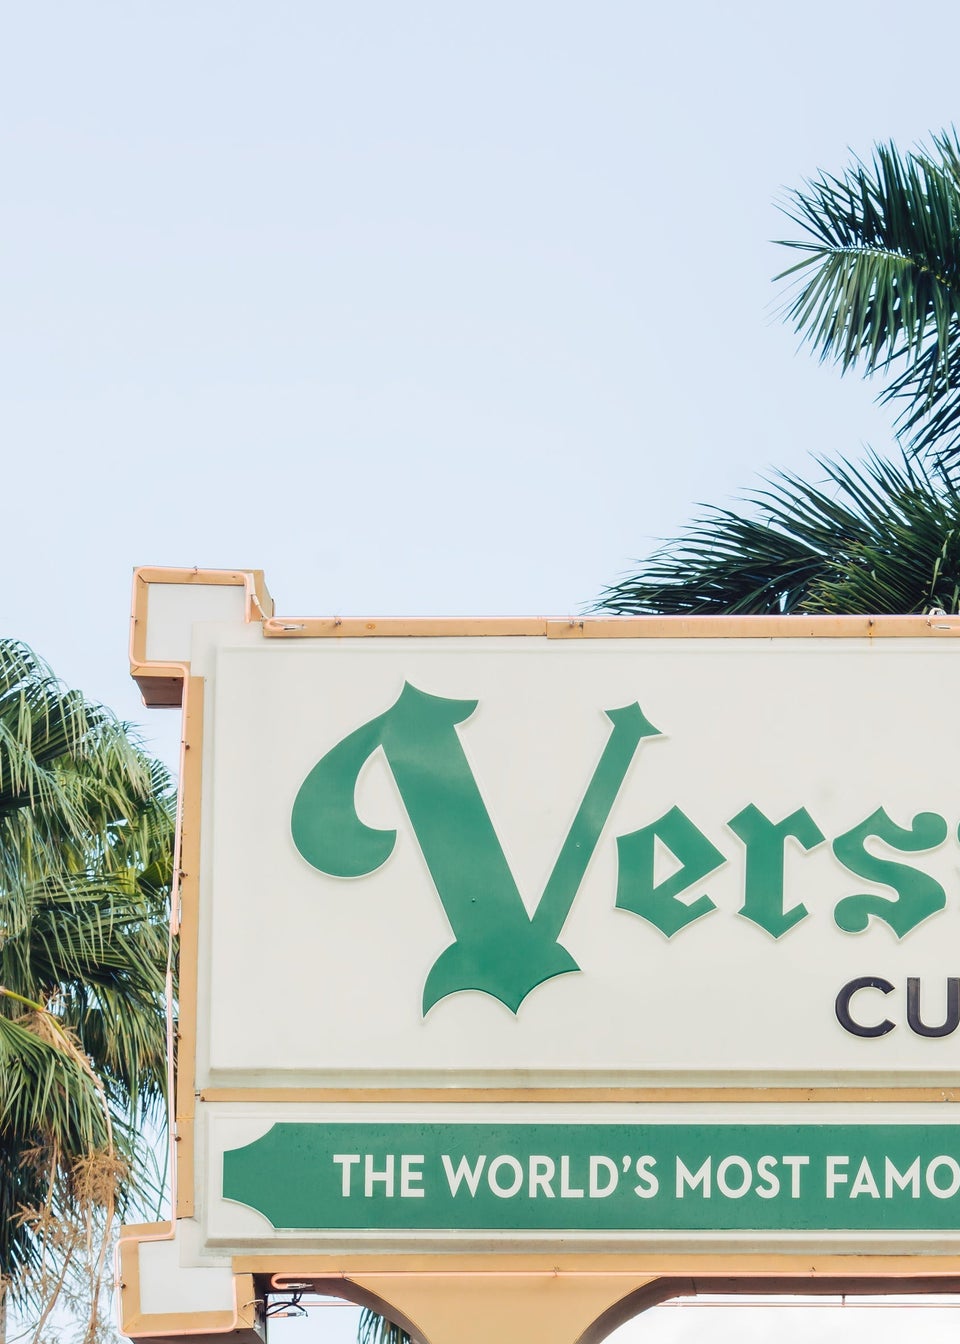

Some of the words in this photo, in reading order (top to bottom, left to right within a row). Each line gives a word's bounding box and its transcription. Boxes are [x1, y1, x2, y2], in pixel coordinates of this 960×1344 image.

[332, 1154, 425, 1199] THE
[441, 1154, 659, 1199] WORLD'S
[675, 1155, 810, 1199] MOST
